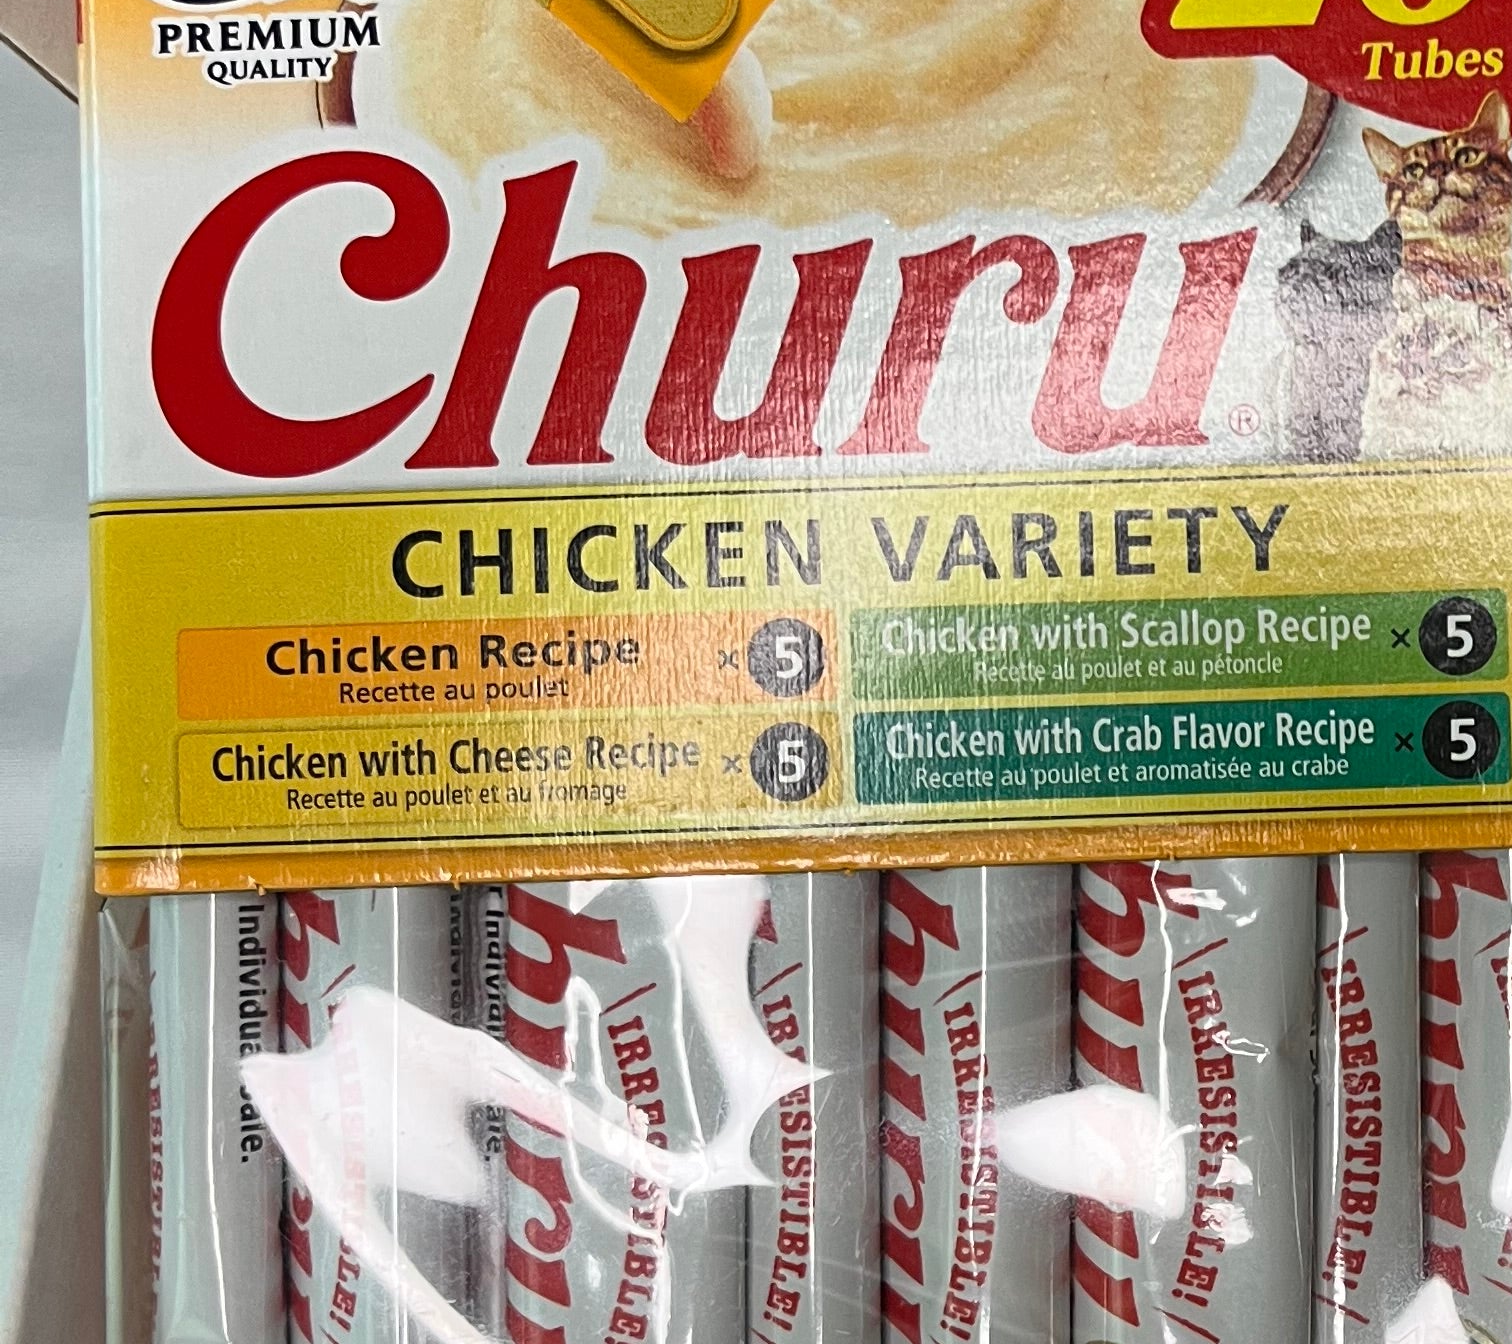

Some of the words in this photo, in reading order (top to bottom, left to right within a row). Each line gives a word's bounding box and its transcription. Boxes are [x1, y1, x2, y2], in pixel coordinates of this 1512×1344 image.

[157, 14, 381, 55] PREMIUM
[1362, 38, 1504, 81] Tubes
[207, 55, 332, 84] QUALITY
[151, 150, 1258, 479] Churu
[391, 518, 823, 599] CHICKEN
[871, 503, 1290, 583] VARIETY
[266, 636, 459, 678] Chicken
[479, 628, 641, 672] Recipe
[775, 636, 803, 678] 5
[882, 616, 1018, 657] Chicken
[1032, 612, 1109, 652] with
[1119, 610, 1246, 658] Scallop
[1257, 605, 1372, 652] Recipe
[1445, 615, 1473, 657] 5
[338, 678, 436, 705] Recette
[444, 682, 477, 702] au
[485, 674, 569, 704] poulet
[974, 658, 1045, 684] Recette
[1051, 661, 1076, 682] au
[1082, 655, 1141, 682] poulet
[1148, 657, 1168, 677] et
[1172, 657, 1196, 677] au
[1202, 652, 1284, 680] pétoncle
[211, 742, 348, 783] Chicken
[359, 740, 436, 778] with
[449, 738, 572, 775] Cheese
[585, 734, 701, 774] Recipe
[777, 740, 806, 784] 5
[885, 718, 1004, 758] Chicken
[1014, 716, 1082, 755] with
[1092, 713, 1162, 752] Crab
[1173, 711, 1268, 750] Flavor
[1276, 708, 1376, 748] Recipe
[1449, 718, 1476, 761] 5
[286, 785, 368, 811] Recette
[374, 788, 398, 808] au
[404, 783, 474, 810] poulet
[480, 785, 500, 804] et
[506, 785, 532, 804] au
[915, 764, 996, 790] Recette
[1001, 766, 1026, 787] au
[1032, 762, 1102, 791] poulet
[1109, 762, 1130, 783] et
[1136, 755, 1254, 780] aromatisée
[1259, 757, 1285, 778] au
[1291, 754, 1350, 777] crabe
[238, 904, 268, 1068] Individua
[1320, 957, 1383, 1292] IRRESISTIBLE!
